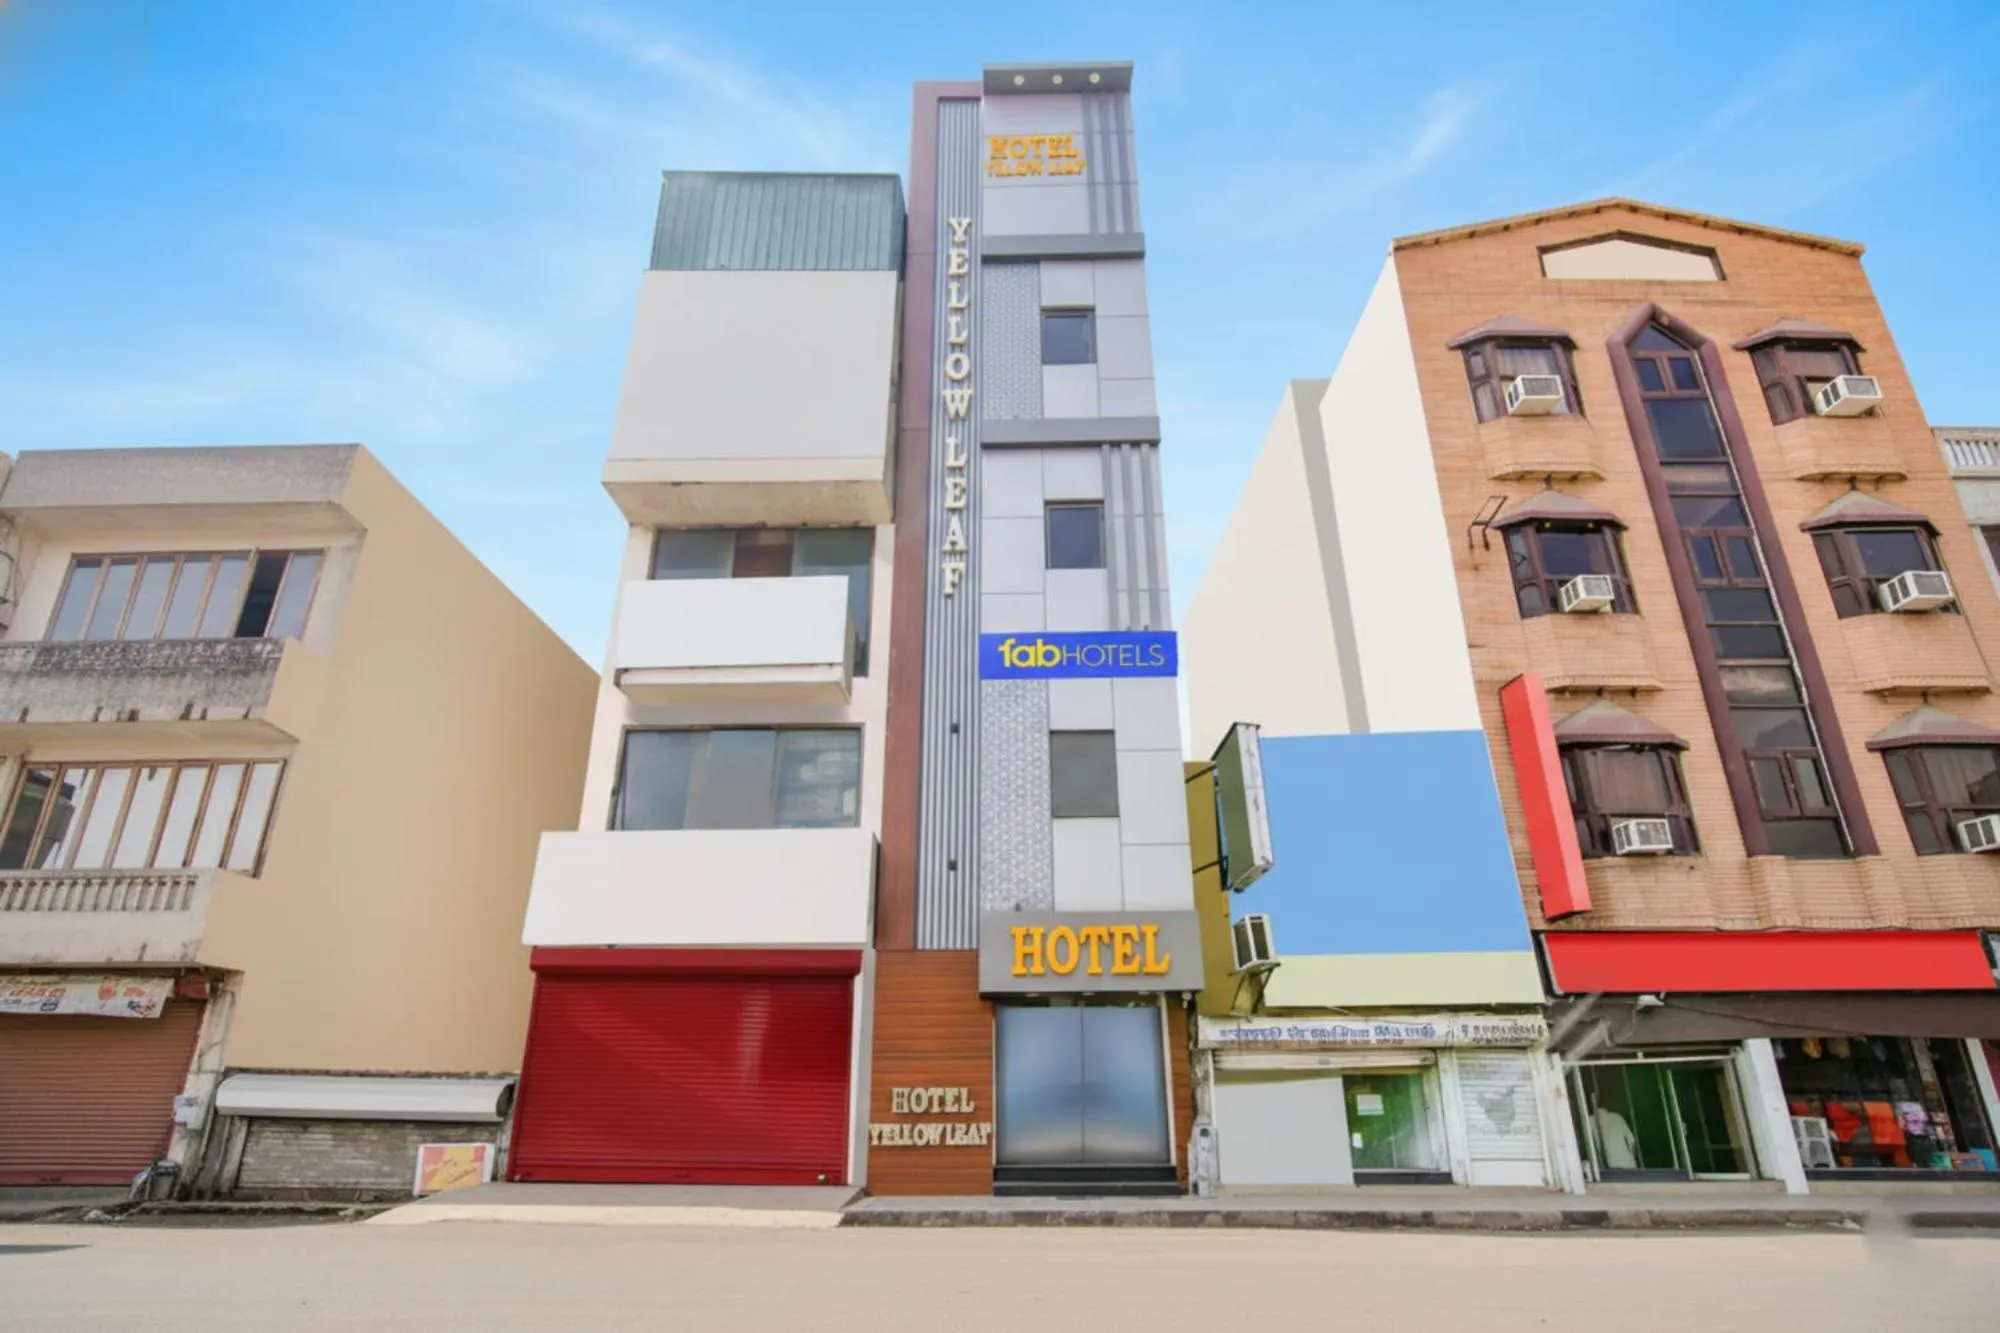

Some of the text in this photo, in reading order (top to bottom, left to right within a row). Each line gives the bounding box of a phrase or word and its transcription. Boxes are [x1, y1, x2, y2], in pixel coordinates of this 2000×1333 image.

[988, 134, 1078, 159] HOTEL
[942, 216, 973, 598] YELLOW LEAF
[1011, 925, 1171, 976] HOTEL
[891, 1087, 976, 1114] HOTEL
[869, 1122, 992, 1146] YELLOW LEAF
